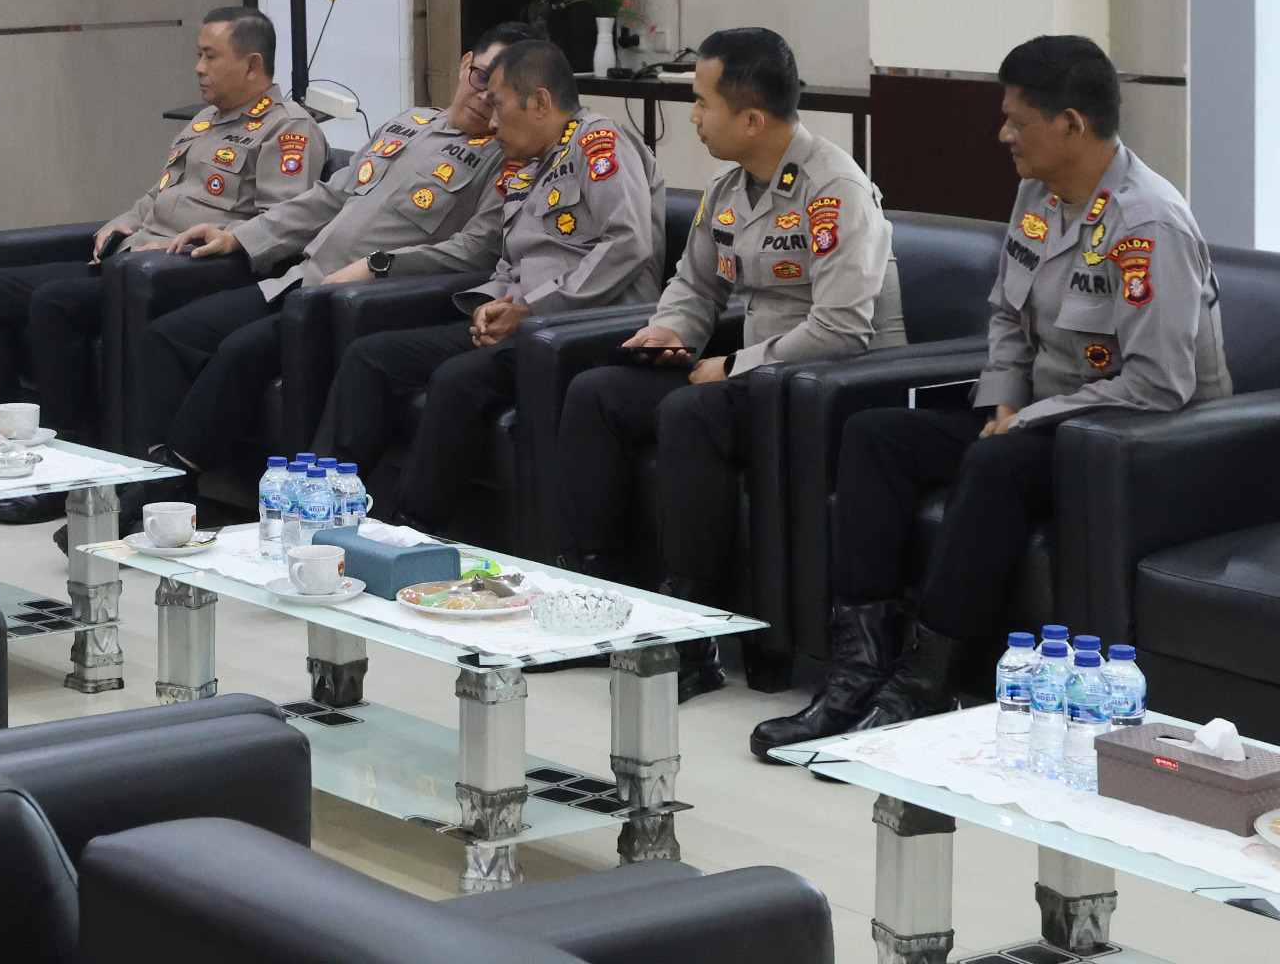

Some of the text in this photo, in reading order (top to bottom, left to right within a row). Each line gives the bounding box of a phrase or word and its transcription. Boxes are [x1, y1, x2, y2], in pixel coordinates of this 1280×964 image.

[280, 134, 305, 142] POLDA
[385, 123, 419, 139] ERLAN
[580, 130, 614, 145] POLDA
[221, 134, 255, 146] POLRI
[441, 142, 482, 169] POLRI
[808, 198, 838, 213] POLDA
[761, 233, 808, 251] POLRI
[1111, 239, 1150, 257] POLDA
[1070, 271, 1112, 295] POLRI
[308, 505, 326, 514] AQUA
[1035, 691, 1057, 703] AQUA
